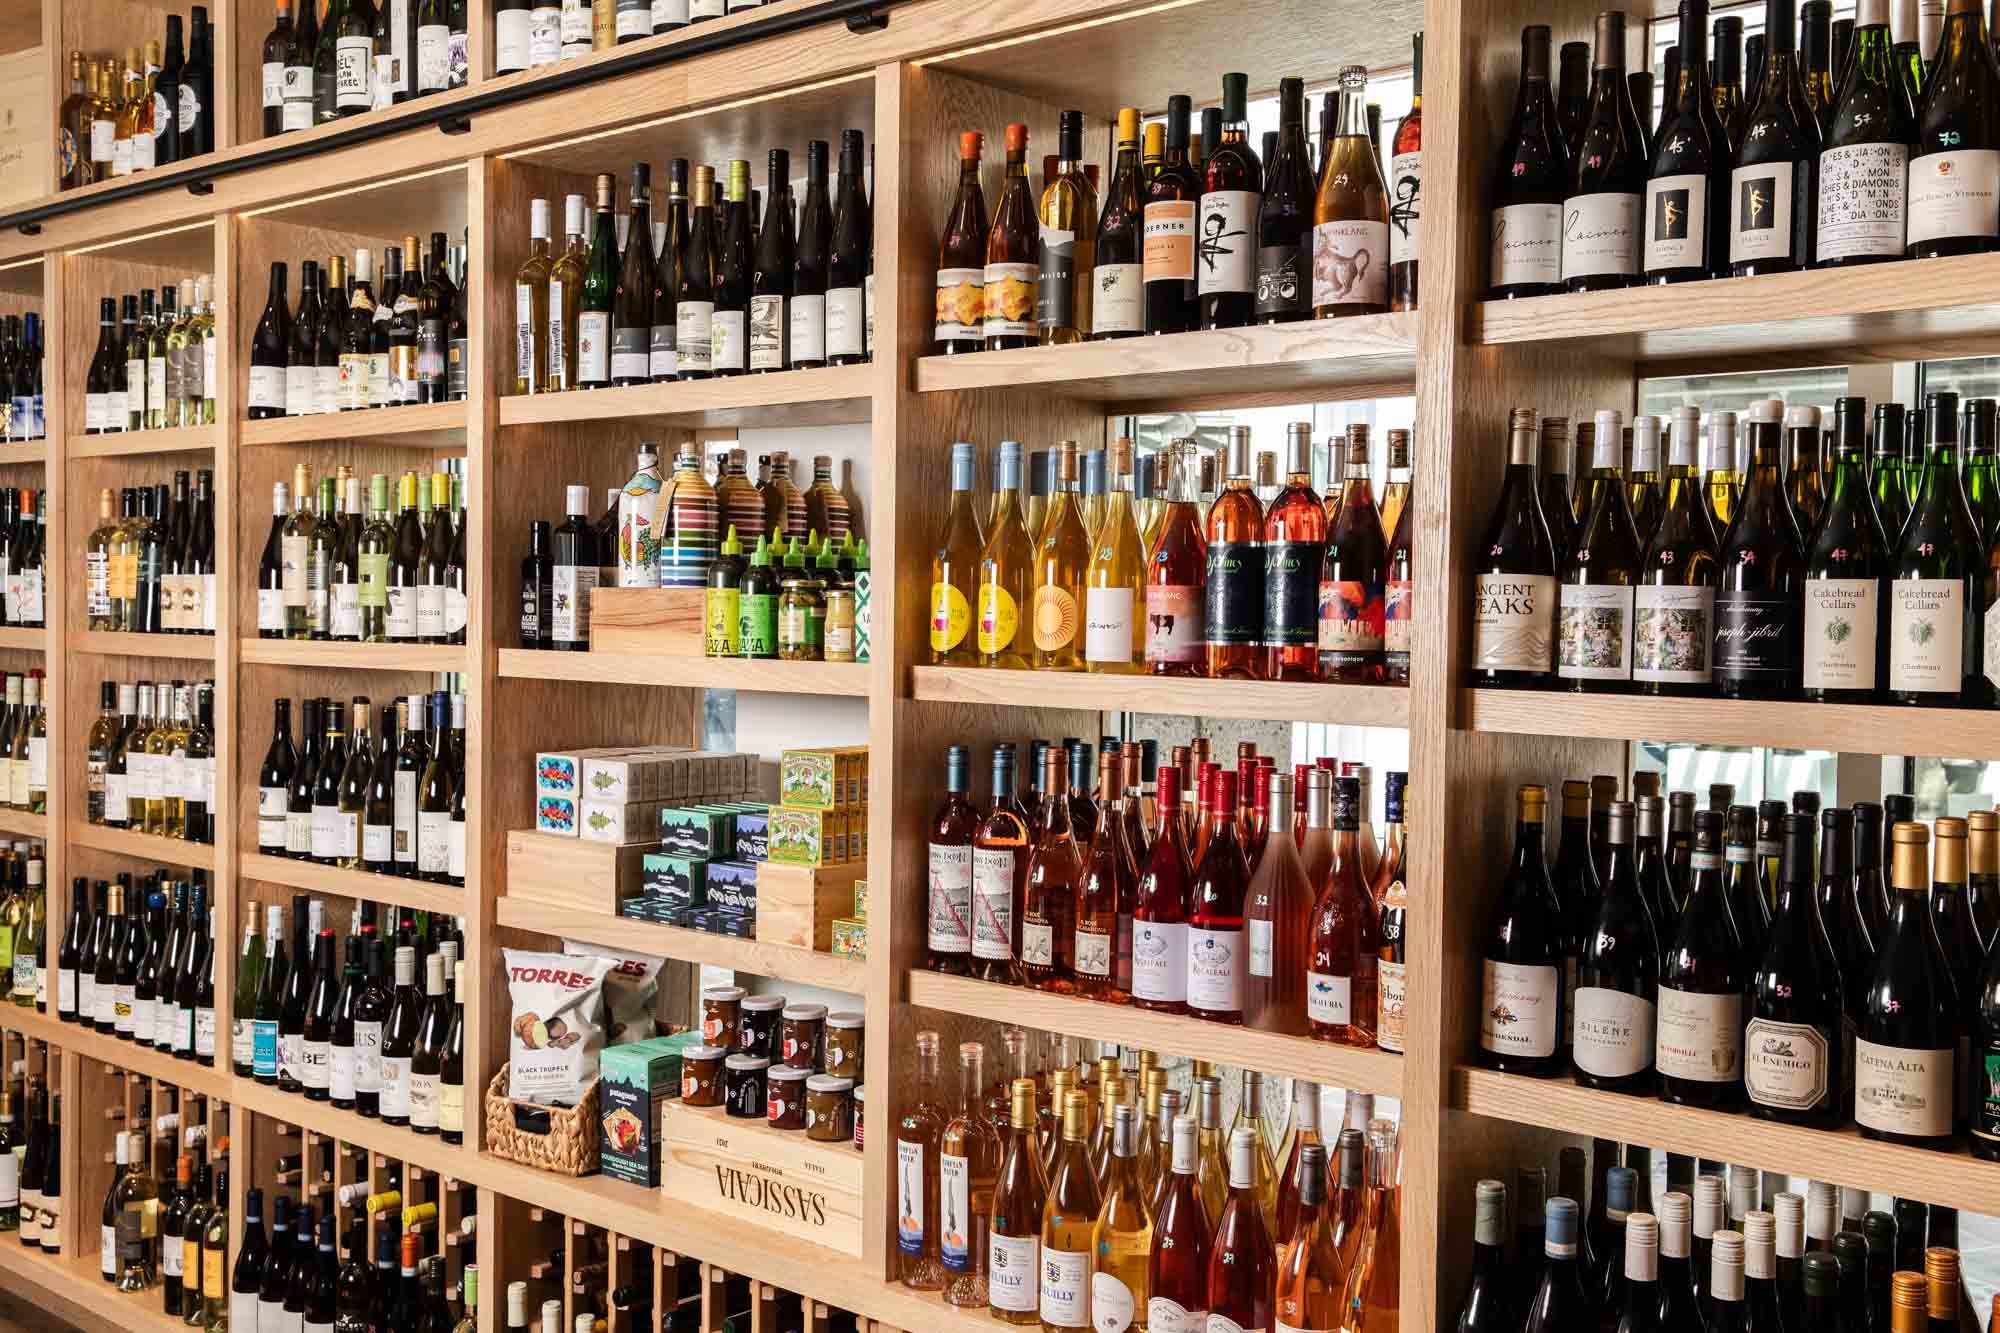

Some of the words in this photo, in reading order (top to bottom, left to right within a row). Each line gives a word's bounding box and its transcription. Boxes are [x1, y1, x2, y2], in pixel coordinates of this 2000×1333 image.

[1669, 136, 1685, 154] 45
[1852, 178, 1900, 190] DIAMONDS
[1813, 587, 1866, 599] Cakebread
[1898, 587, 1951, 599] Cakebread
[1821, 599, 1857, 609] Cellars
[1904, 599, 1941, 610] Cellars
[511, 966, 596, 990] TORRES
[1762, 1055, 1811, 1071] ENEMIGO
[1860, 1052, 1894, 1070] CATENA
[1897, 1060, 1925, 1074] ALTA
[518, 1066, 538, 1074] BLACK
[540, 1065, 569, 1073] TRUFFLE
[715, 1164, 825, 1226] SASSICAIA
